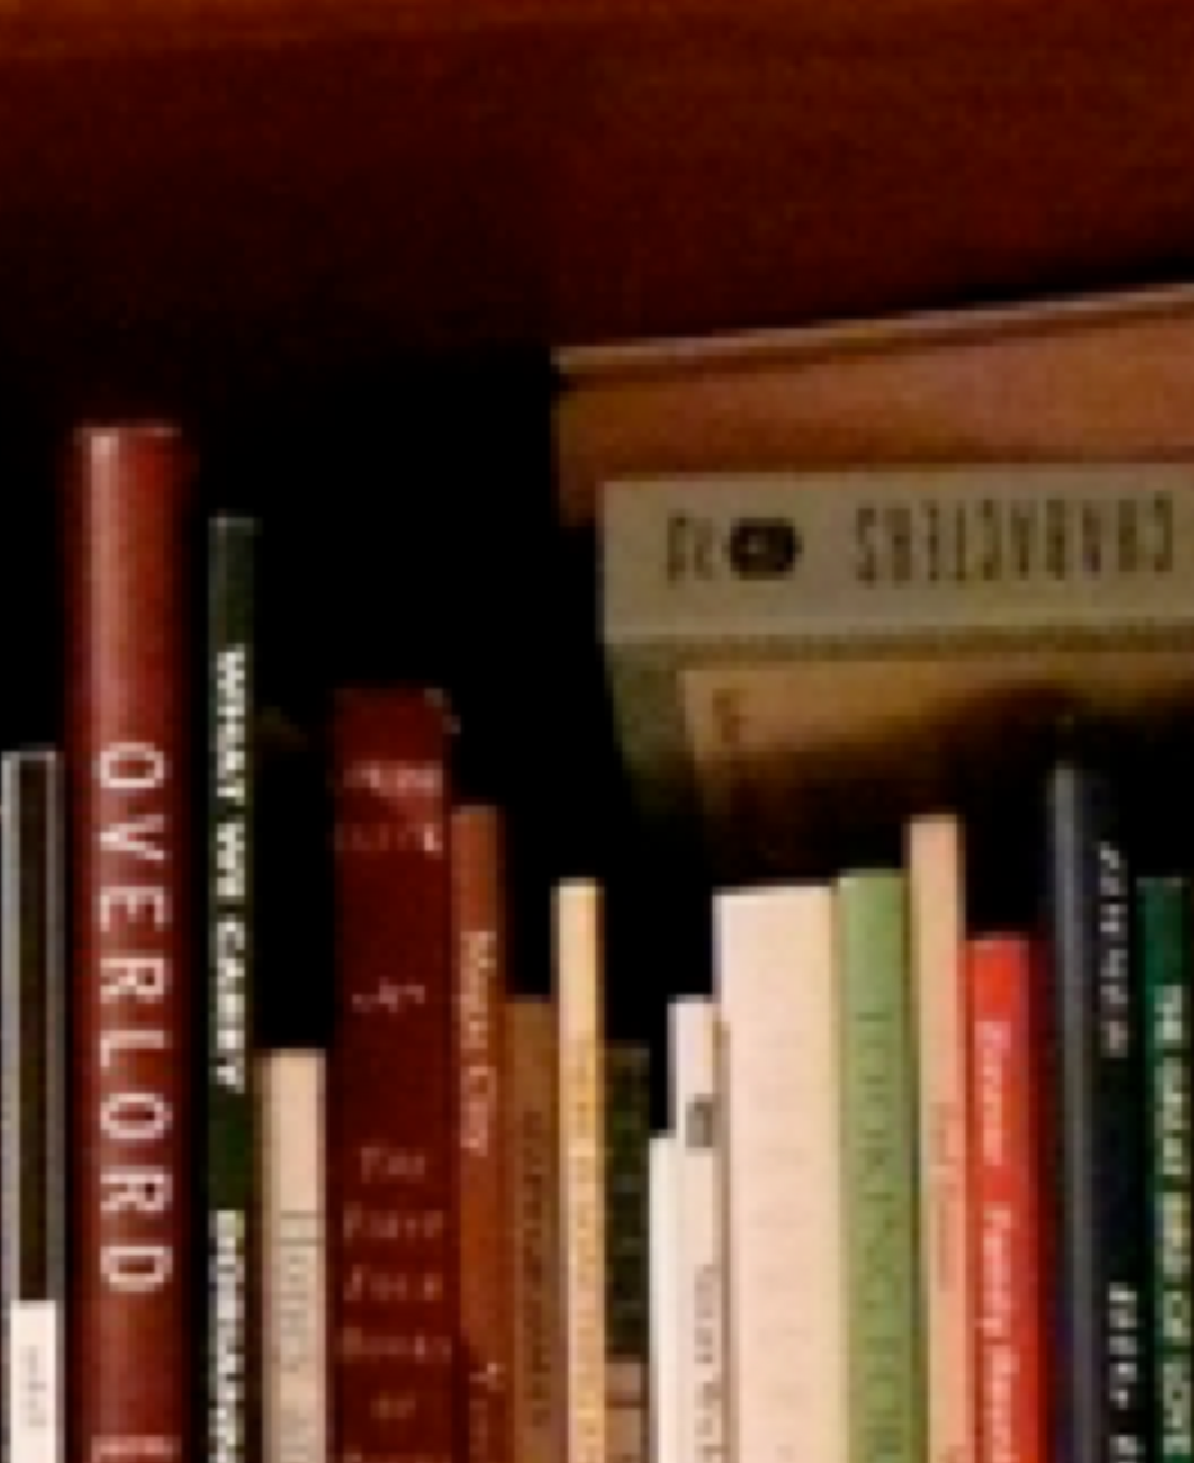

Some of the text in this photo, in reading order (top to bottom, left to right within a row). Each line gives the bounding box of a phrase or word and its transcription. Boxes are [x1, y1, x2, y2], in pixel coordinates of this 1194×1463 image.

[213, 645, 248, 805] WHAT
[214, 819, 248, 903] WE
[97, 740, 171, 1297] OVERLORD
[212, 917, 246, 1093] CARRY
[457, 929, 498, 1054] Magic
[1153, 983, 1186, 1050] THE
[458, 1062, 501, 1159] City
[1155, 1057, 1190, 1179] GREAT
[1158, 1192, 1191, 1279] BIRD
[1159, 1288, 1192, 1345] OF
[1162, 1360, 1194, 1458] LOVE
